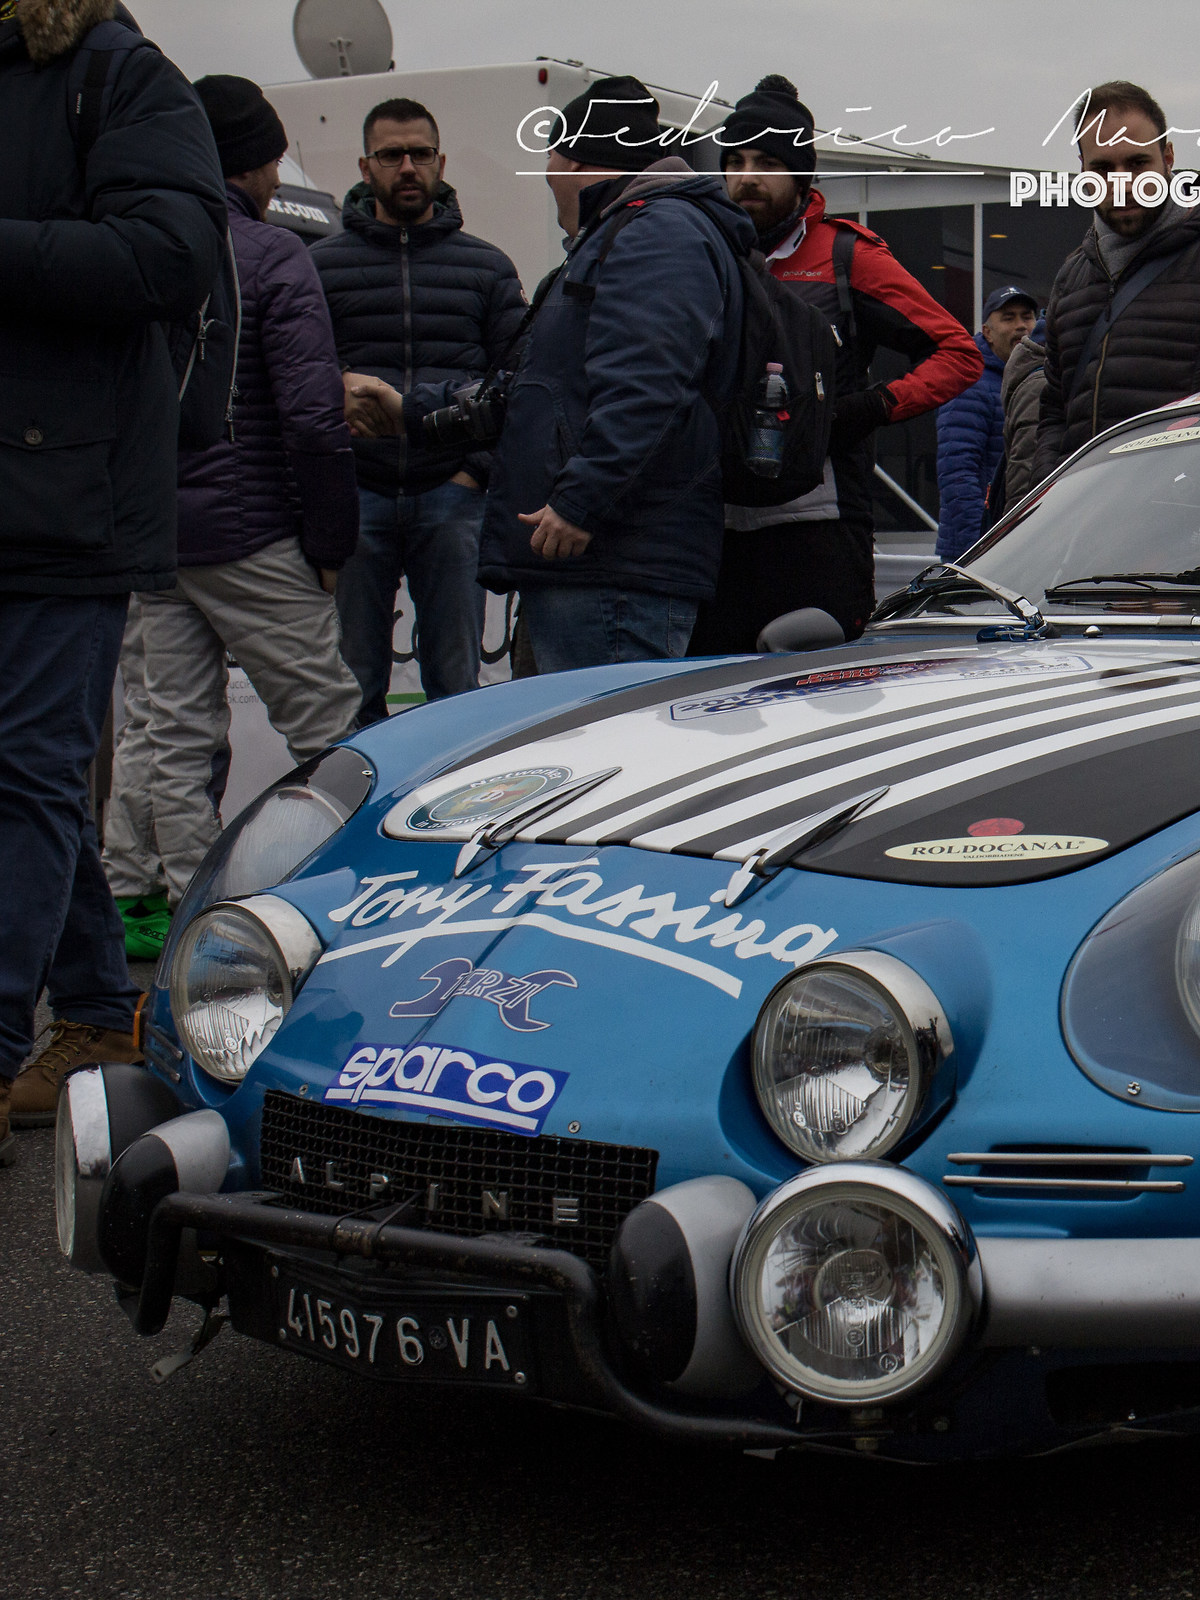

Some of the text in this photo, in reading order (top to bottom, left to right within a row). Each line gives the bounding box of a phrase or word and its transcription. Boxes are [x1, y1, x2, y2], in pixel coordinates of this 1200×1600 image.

[676, 690, 768, 713] 2016
[911, 841, 1081, 856] ROLDOCANAL
[328, 857, 839, 968] Tony Fassina
[340, 1044, 556, 1112] sparco
[289, 1155, 580, 1226] ALPINE
[446, 1317, 511, 1372] VA
